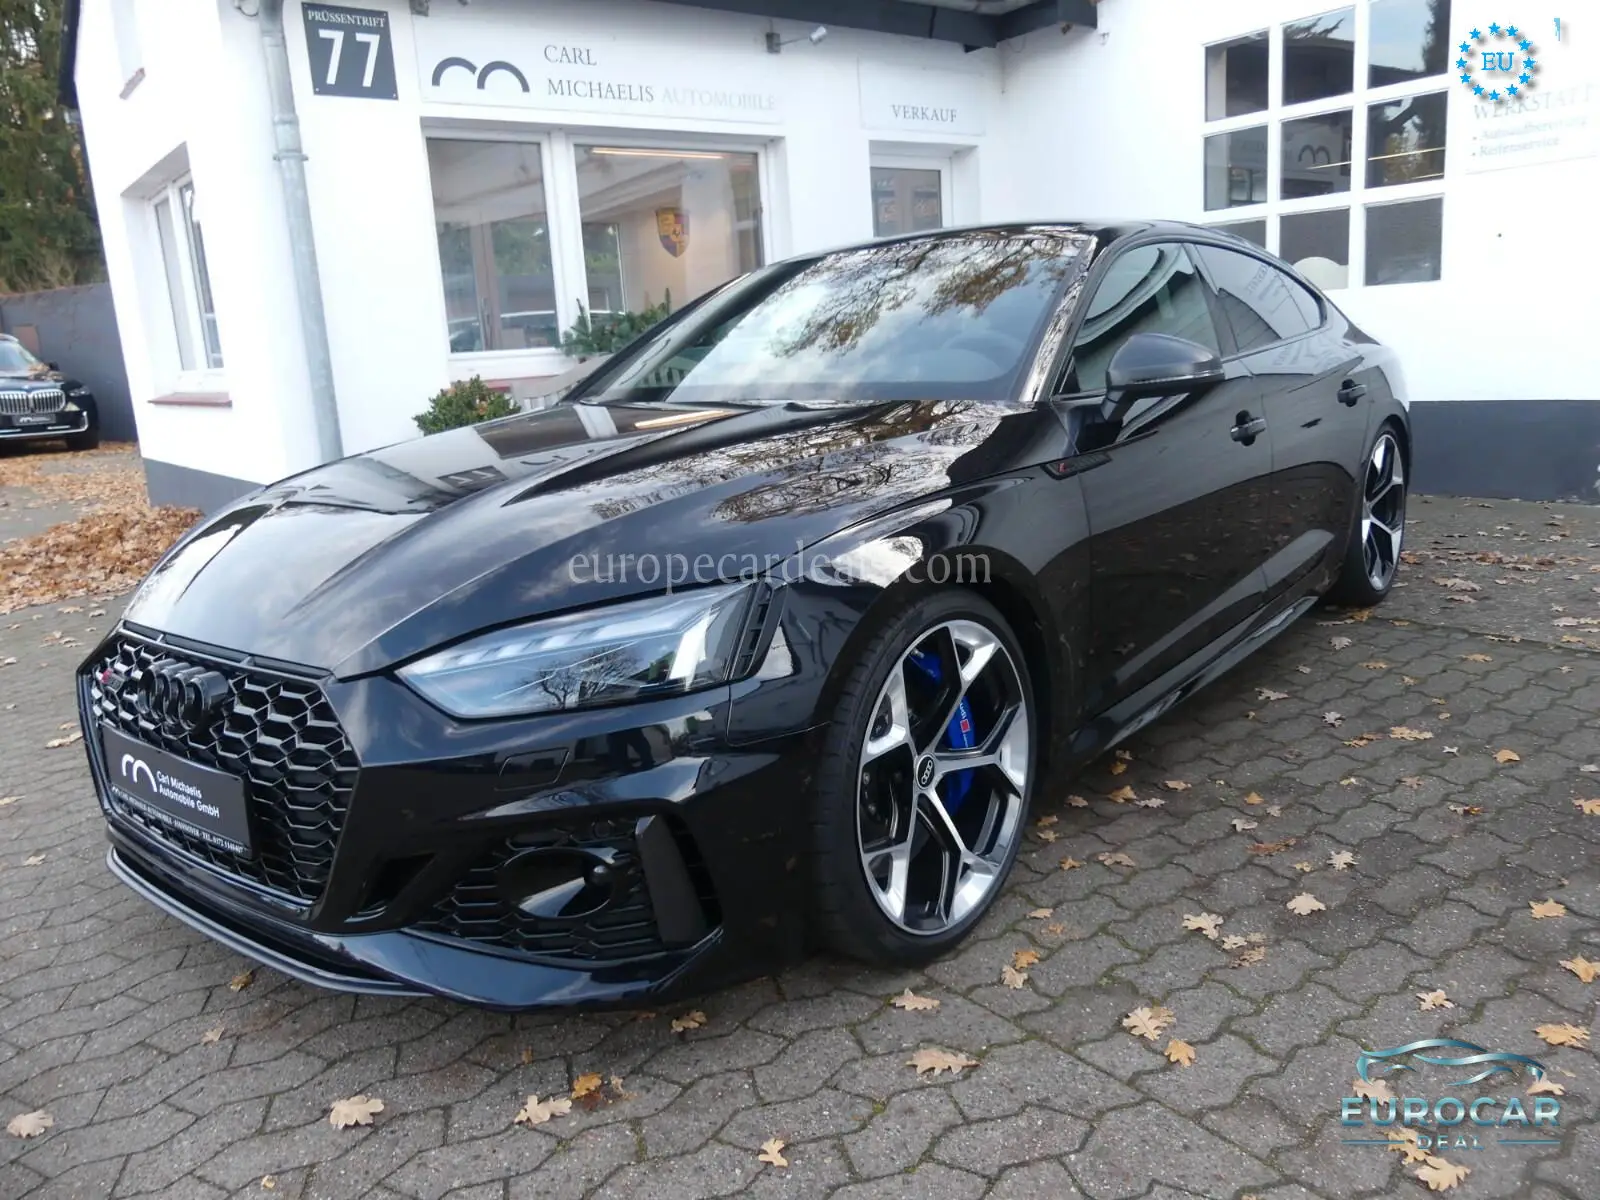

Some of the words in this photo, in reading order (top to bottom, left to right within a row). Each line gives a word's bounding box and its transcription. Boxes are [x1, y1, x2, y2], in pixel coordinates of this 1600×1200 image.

[307, 9, 386, 28] PRÜSSENTRIFT
[318, 28, 381, 88] 77
[544, 45, 597, 66] CARL
[547, 78, 655, 103] MICHAELIS
[890, 103, 958, 123] VERKAUF
[156, 770, 170, 786] Carl
[170, 775, 203, 799] Michaelis
[159, 783, 196, 809] Automobile
[196, 799, 220, 819] GmbH
